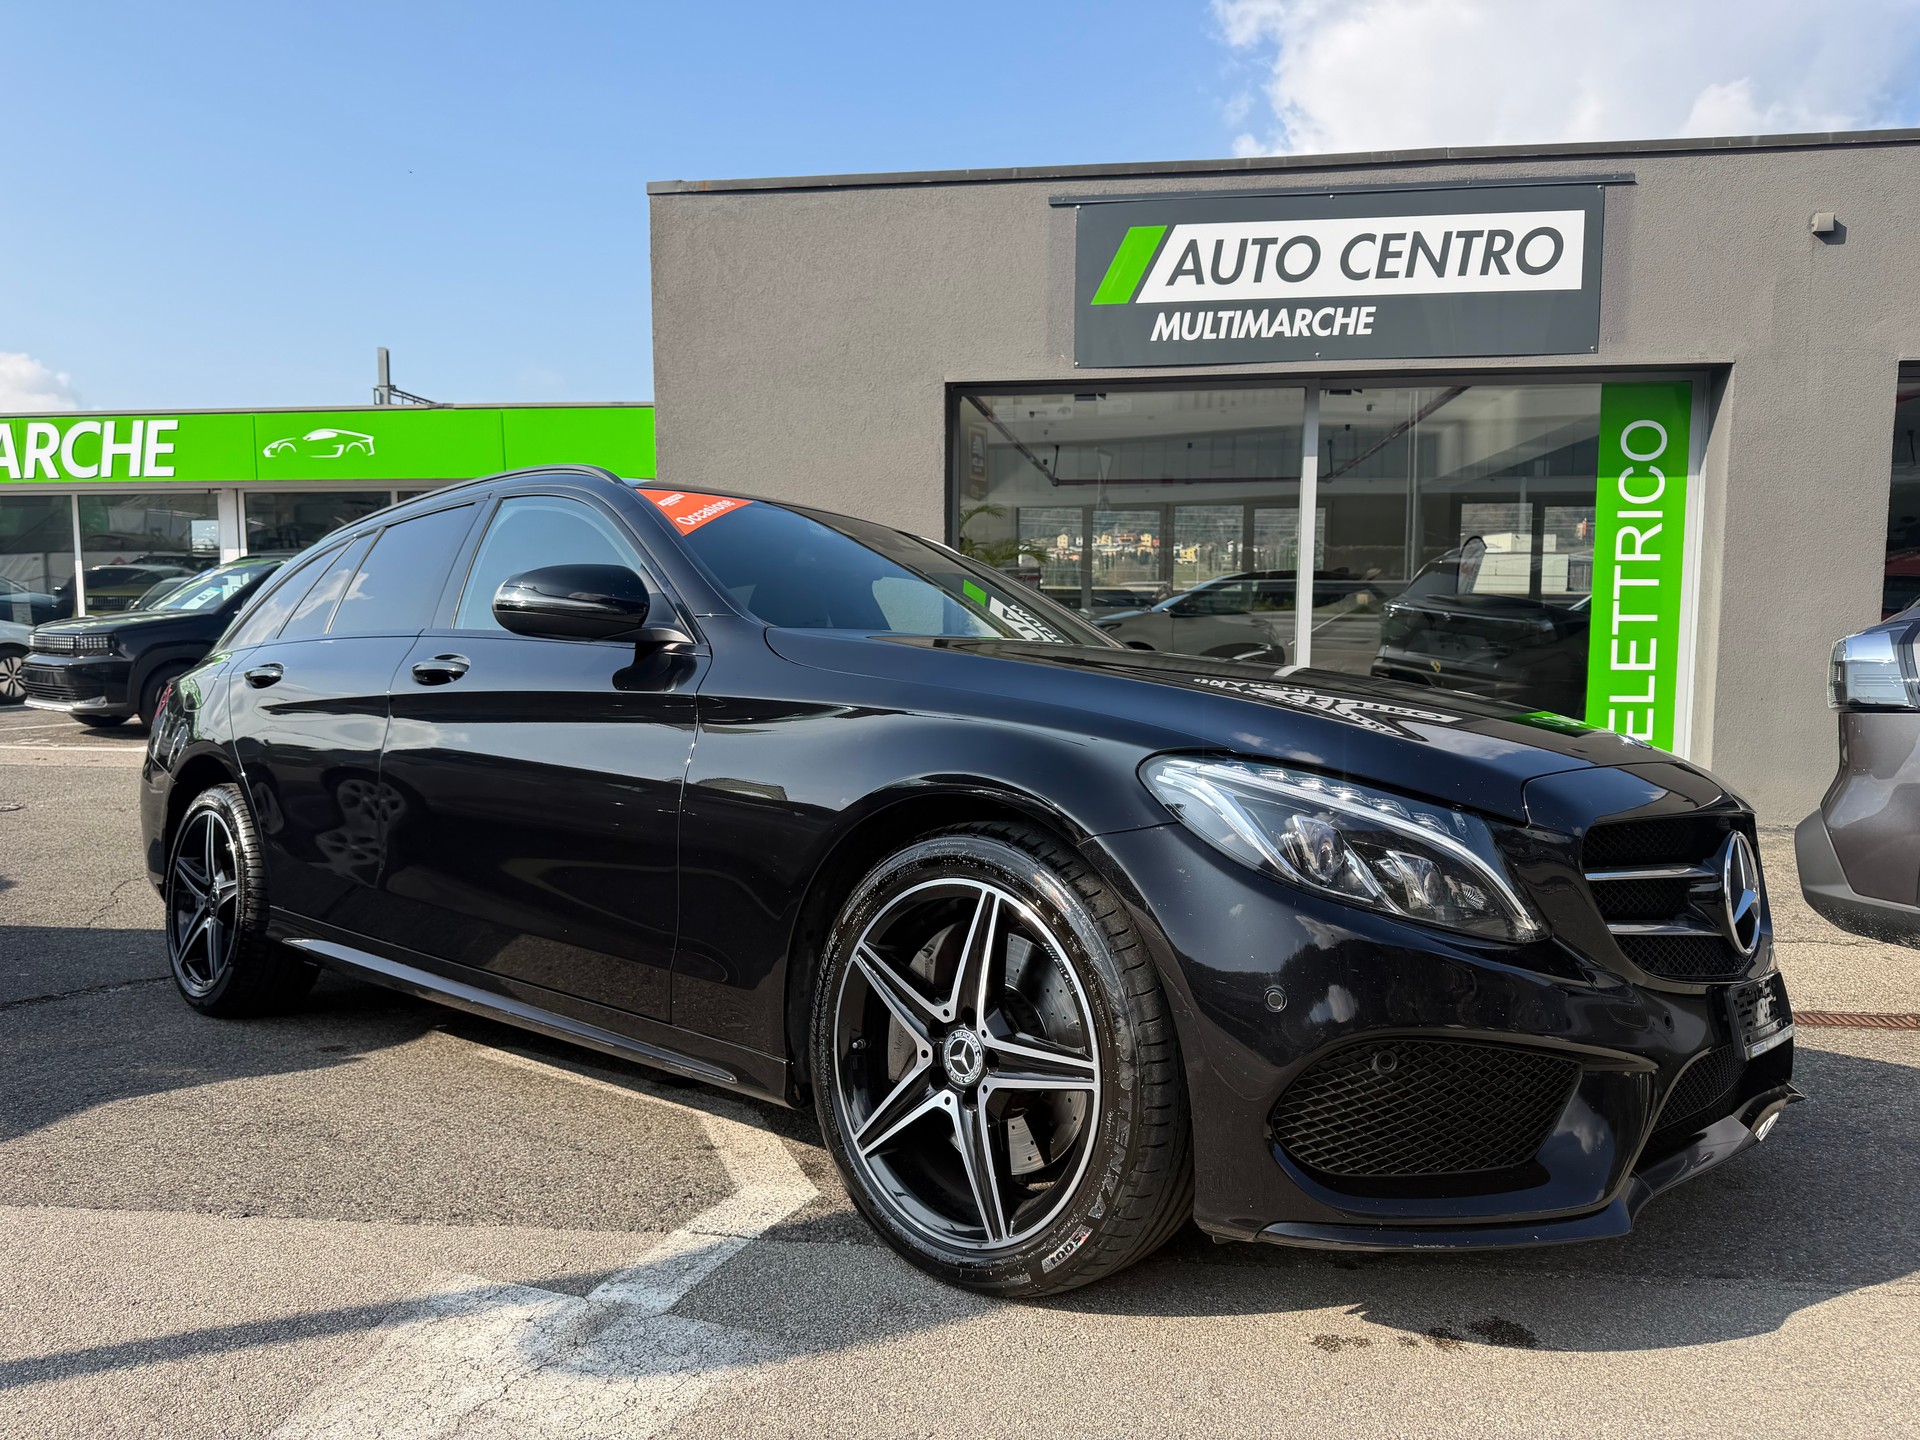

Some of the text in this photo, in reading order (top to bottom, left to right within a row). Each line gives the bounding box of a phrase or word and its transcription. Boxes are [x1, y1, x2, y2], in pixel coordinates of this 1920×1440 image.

[1165, 226, 1564, 286] AUTO CENTRO
[1149, 305, 1377, 342] MULTIMARCHE
[675, 499, 736, 526] Occasione
[1607, 419, 1668, 740] ELETTRICO
